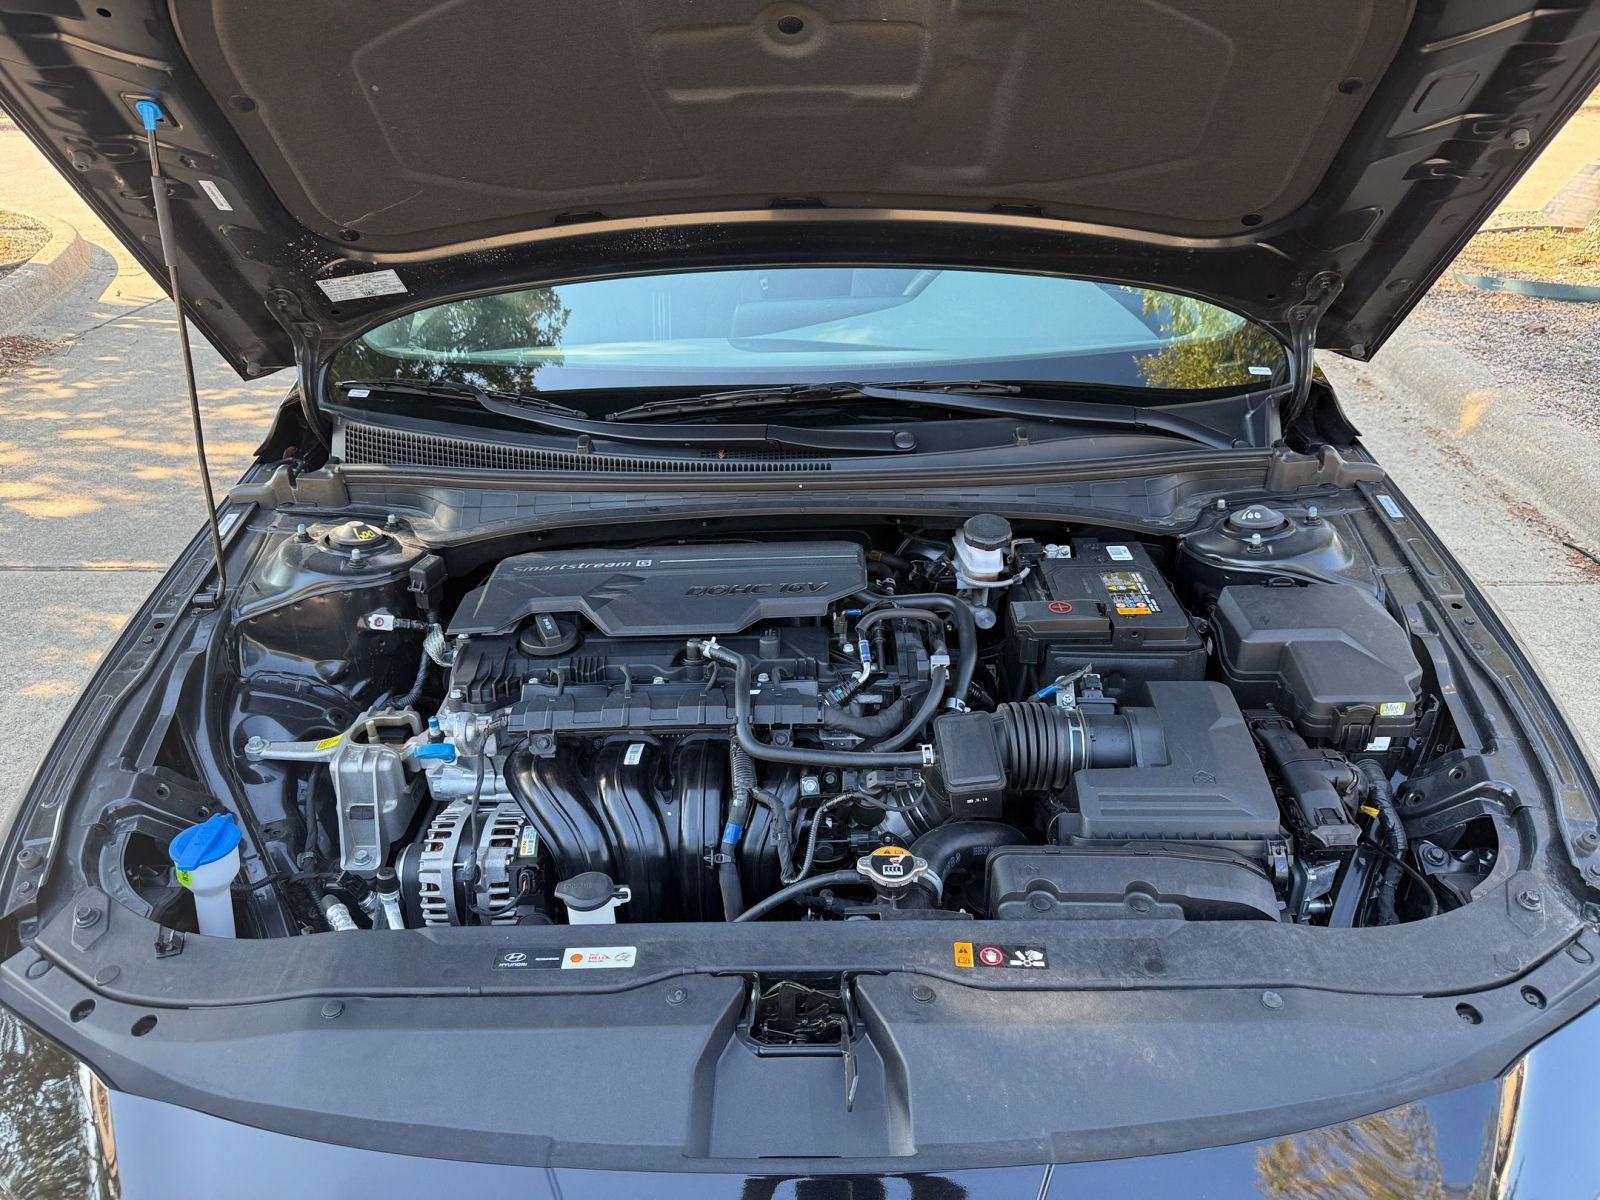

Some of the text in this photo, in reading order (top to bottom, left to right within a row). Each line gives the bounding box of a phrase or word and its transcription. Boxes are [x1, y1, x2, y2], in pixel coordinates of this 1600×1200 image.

[512, 560, 633, 573] Smartstream
[685, 581, 830, 597] DOHC 16V
